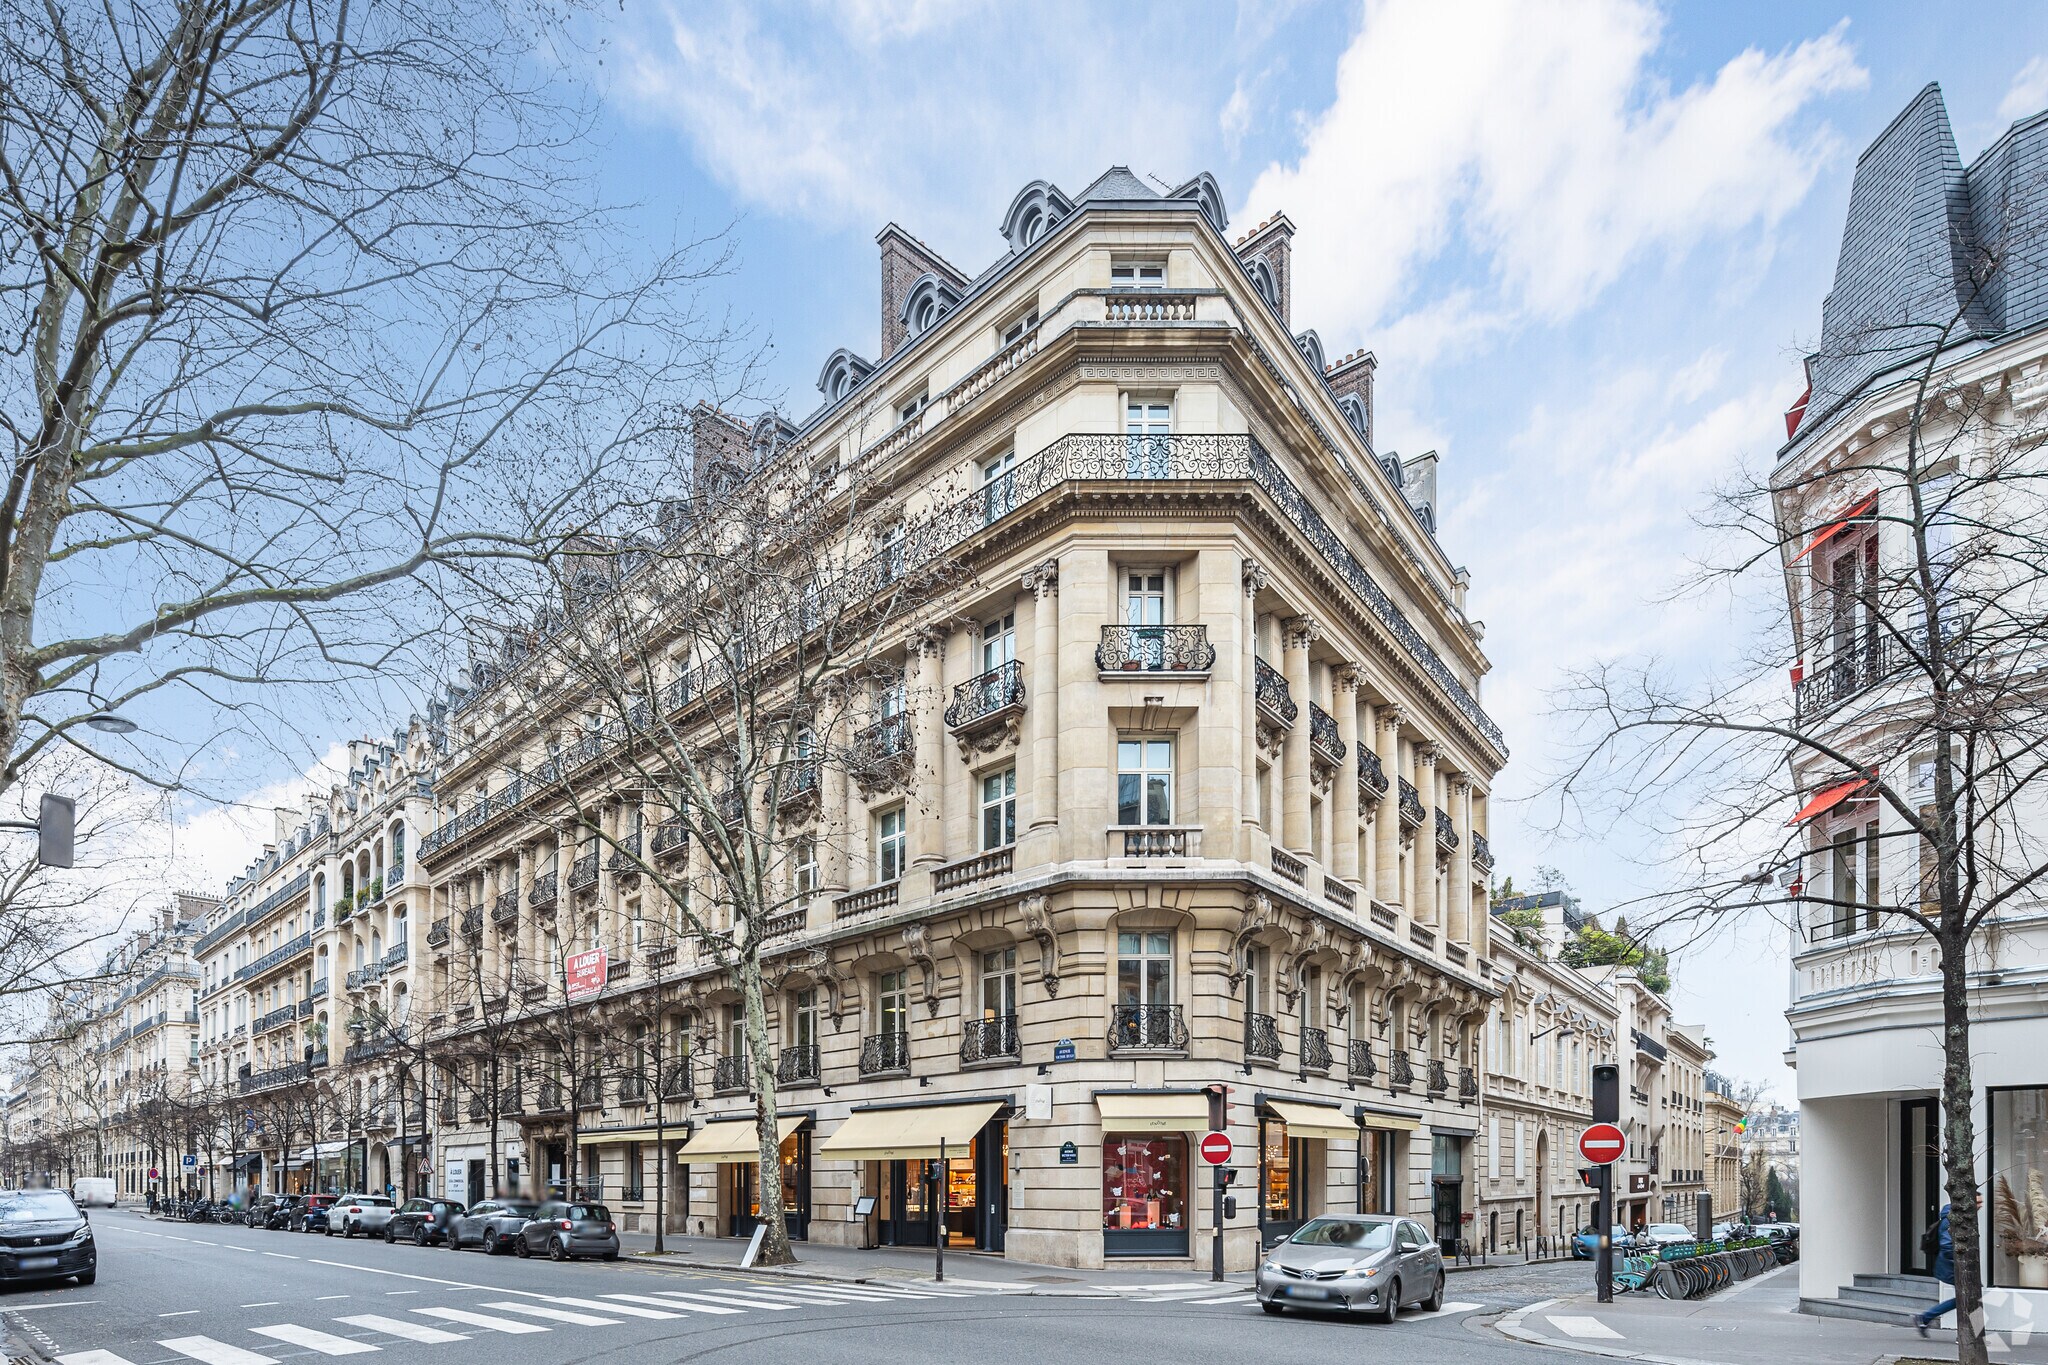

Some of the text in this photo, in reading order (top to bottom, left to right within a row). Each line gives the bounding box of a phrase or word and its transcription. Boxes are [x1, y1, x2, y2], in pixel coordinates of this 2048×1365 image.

[573, 952, 600, 970] A LOUER
[576, 966, 596, 978] BUREAUX
